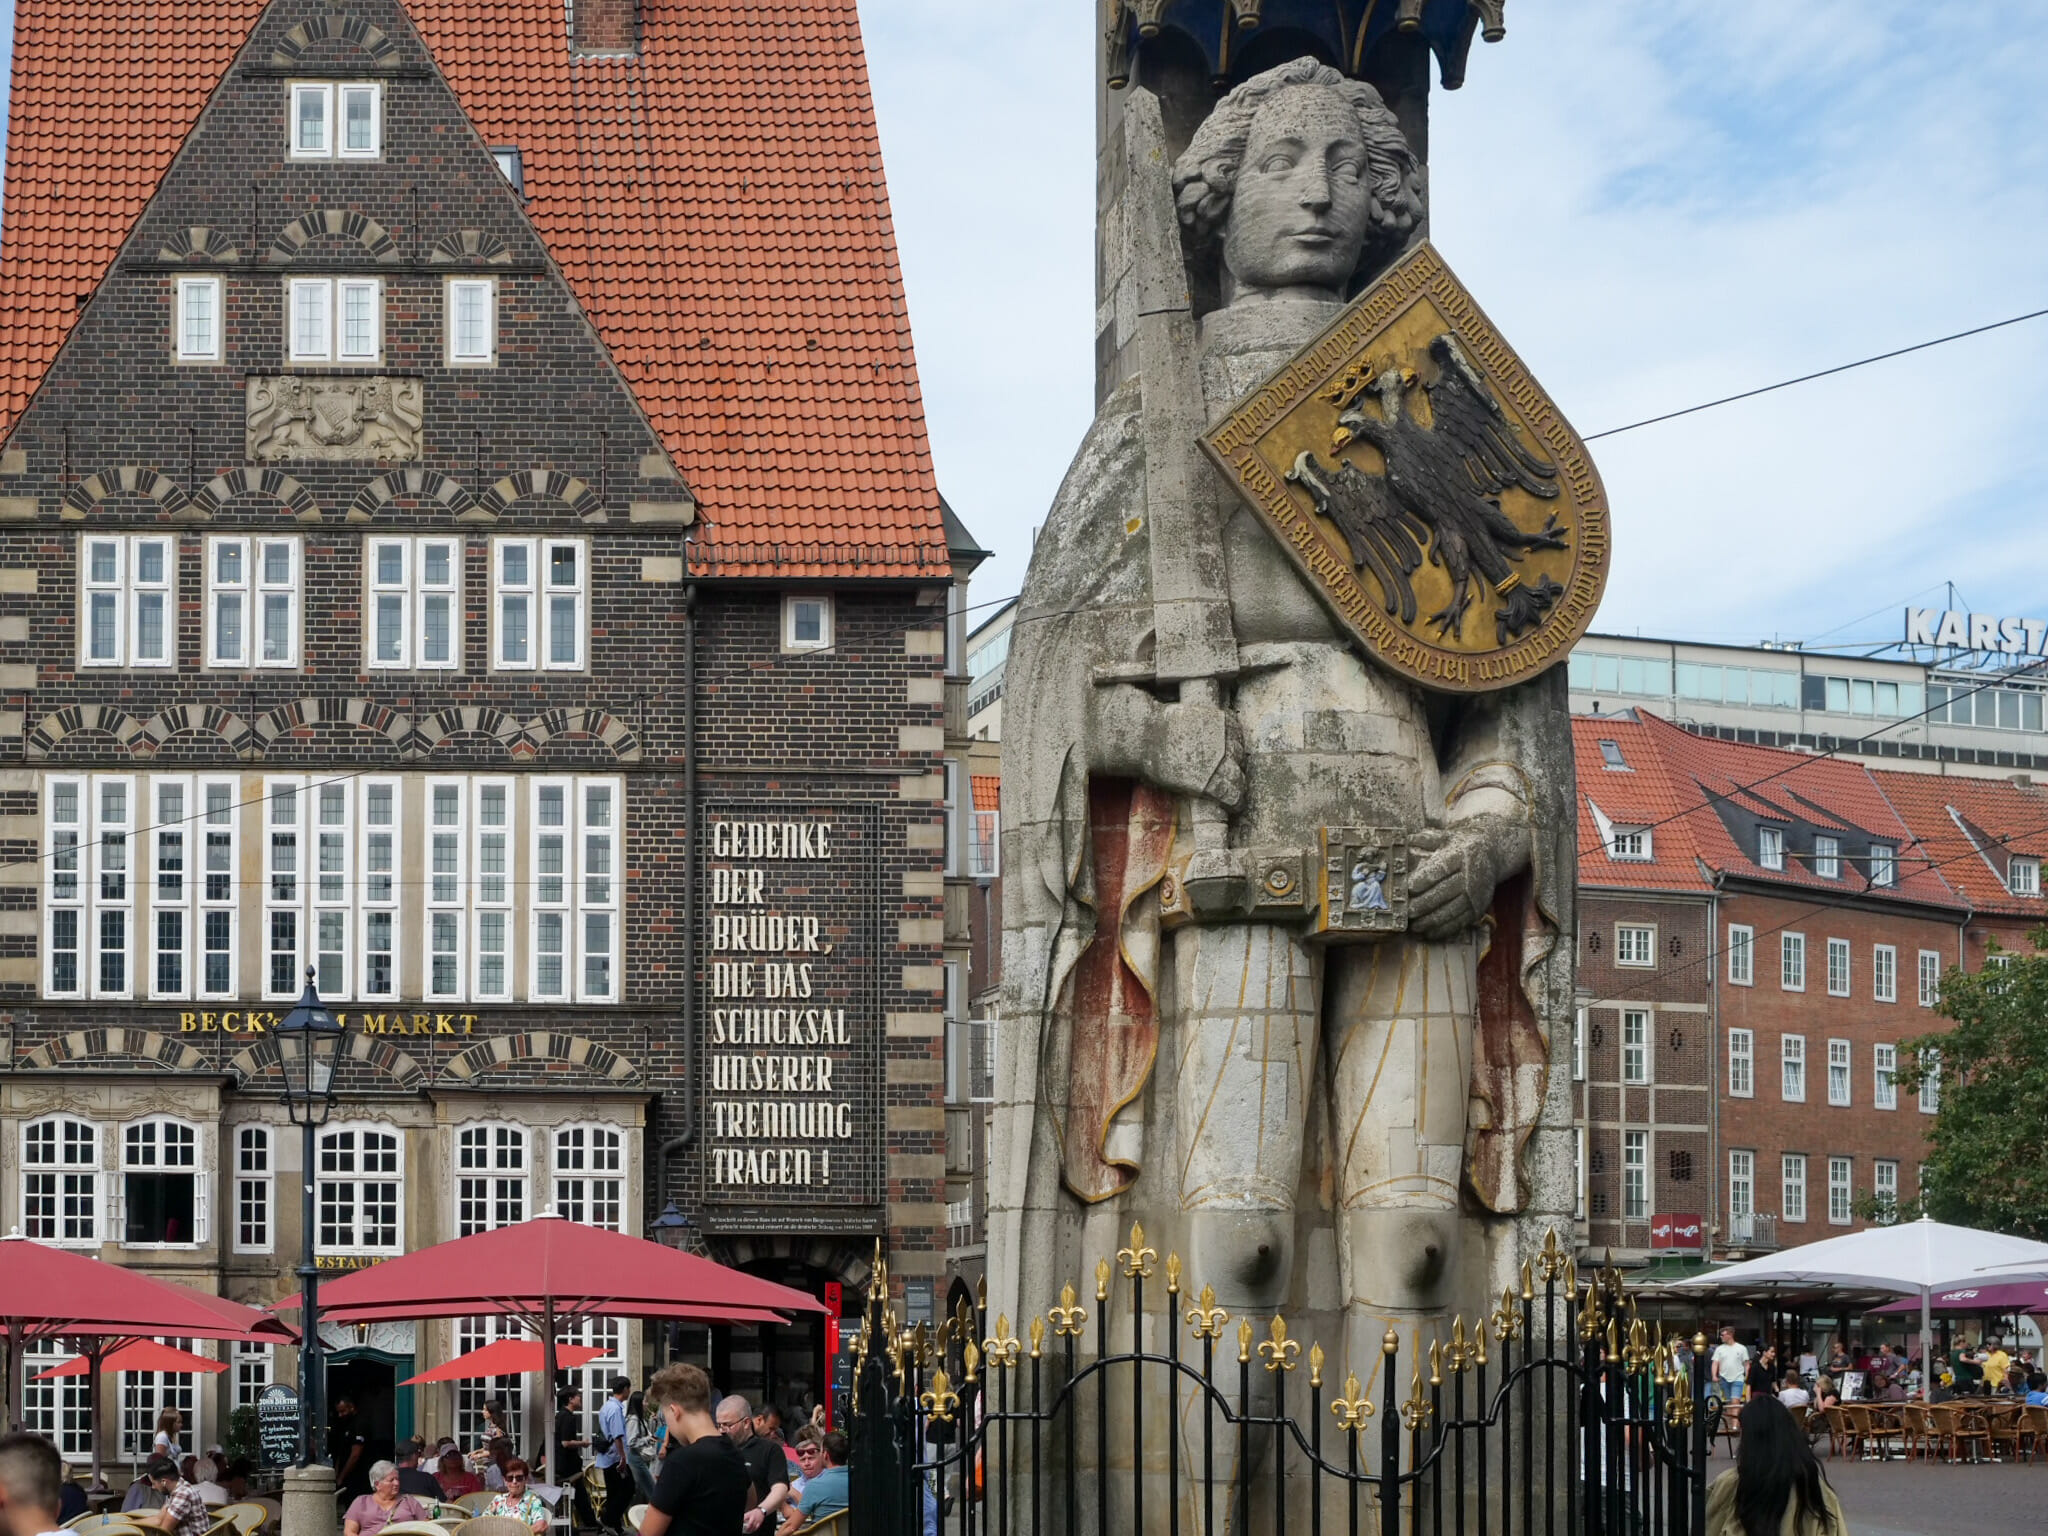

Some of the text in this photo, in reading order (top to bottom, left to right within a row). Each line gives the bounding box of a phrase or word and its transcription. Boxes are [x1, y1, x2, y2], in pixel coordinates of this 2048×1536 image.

[713, 821, 832, 859] GEDENKE
[713, 868, 764, 904] DER
[713, 909, 833, 955] BRÜDER,
[713, 962, 812, 998] DIE DAS
[363, 1014, 478, 1034] MARKT
[713, 1008, 851, 1045] SCHICKSAL
[713, 1055, 832, 1091] UNSERER
[712, 1101, 851, 1138] TRENNUNG
[315, 1256, 391, 1269] ESTAUR
